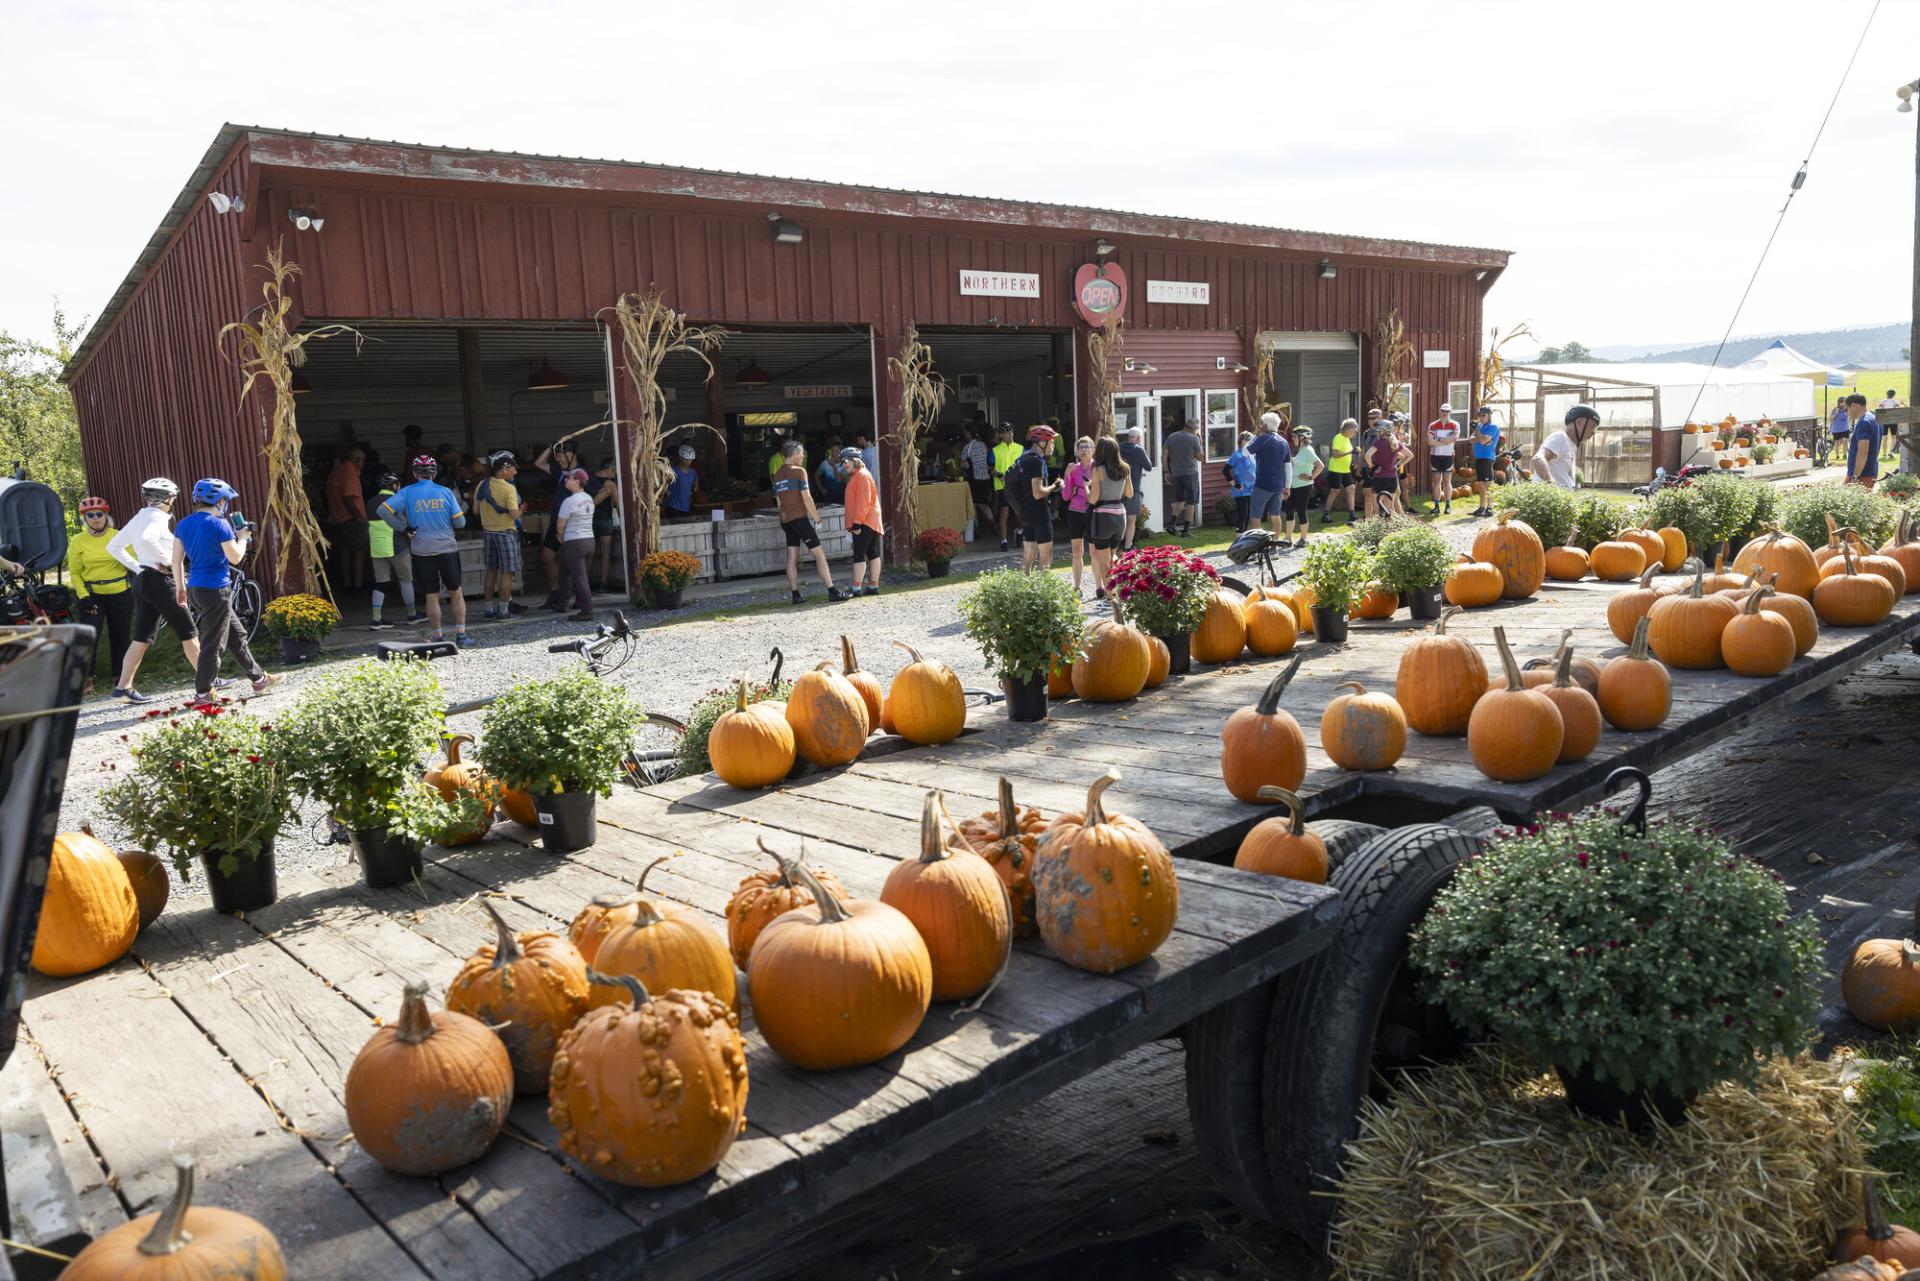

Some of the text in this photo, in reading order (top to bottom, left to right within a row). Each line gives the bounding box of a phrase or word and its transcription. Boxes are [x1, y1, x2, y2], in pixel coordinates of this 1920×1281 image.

[963, 275, 1036, 291] NORTHERN
[1082, 287, 1119, 305] OPEN
[790, 386, 849, 398] VEGETABLES
[422, 498, 446, 510] VBT
